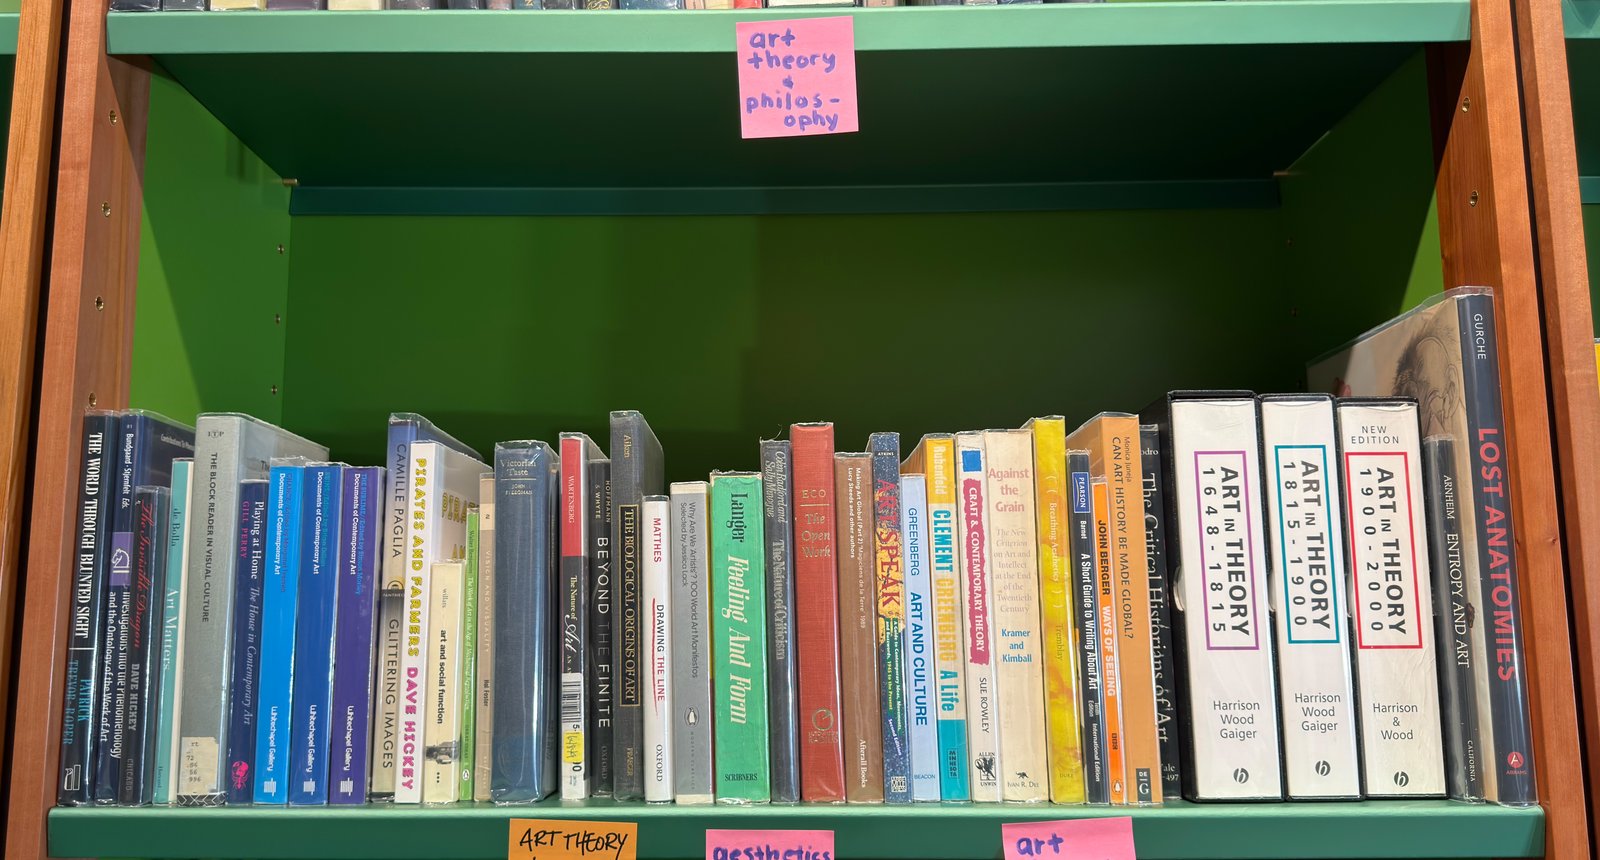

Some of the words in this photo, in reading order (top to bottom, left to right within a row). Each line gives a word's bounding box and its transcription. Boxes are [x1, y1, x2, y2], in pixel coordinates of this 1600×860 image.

[750, 28, 796, 49] art
[747, 50, 836, 73] theory
[783, 110, 838, 131] ophy
[1474, 313, 1486, 360] GURCHE
[88, 433, 102, 454] THE
[1351, 435, 1400, 445] EDITION
[1361, 426, 1387, 434] NEW
[210, 453, 218, 470] THE
[1112, 437, 1121, 460] CAN
[1478, 428, 1503, 498] LOST
[86, 458, 101, 495] WORLD
[394, 444, 407, 502] CAMILLE
[933, 446, 947, 495] Rubenfeld
[988, 467, 1029, 482] Against
[1114, 463, 1123, 483] ART
[1301, 460, 1322, 506] ART
[209, 471, 217, 501] BLOCK
[413, 458, 427, 531] PIRATES
[801, 489, 827, 499] ECO
[1000, 484, 1019, 496] the
[1142, 473, 1157, 509] The
[1220, 466, 1241, 512] ART
[1376, 467, 1397, 513] ART
[1443, 475, 1455, 519] ARNHEIM
[969, 487, 978, 516] CRAFT
[995, 501, 1025, 512] Grain
[1115, 487, 1126, 533] HISTORY
[81, 499, 98, 548] THROUGH
[207, 502, 216, 535] READER
[251, 501, 264, 535] Playing
[392, 508, 405, 558] PAGLIA
[624, 509, 635, 533] THE
[726, 493, 748, 543] Langer
[804, 512, 826, 525] The
[970, 520, 978, 529] &
[1080, 520, 1088, 539] Barnet
[1224, 519, 1235, 532] IN
[1304, 513, 1316, 526] IN
[1381, 519, 1392, 532] IN
[206, 538, 213, 547] IN
[240, 528, 248, 558] PERRY
[253, 538, 260, 547] at
[653, 518, 662, 562] MATTHES
[801, 530, 831, 543] Open
[908, 508, 920, 575] GREENBERG
[933, 510, 953, 572] CLEMENT
[1098, 520, 1108, 548] JOHN
[1118, 537, 1127, 549] BE
[1145, 512, 1162, 580] Critical
[204, 549, 213, 580] VISUAL
[251, 550, 261, 579] Home
[411, 535, 424, 571] AND
[772, 540, 784, 560] The
[801, 545, 831, 558] Work
[77, 554, 94, 603] BLUNTED
[598, 537, 610, 614] BEYOND
[624, 536, 635, 606] BIOLOGICAL
[773, 561, 785, 598] Nature
[971, 531, 983, 610] CONTEMPORARY
[1082, 561, 1091, 583] Short
[1100, 551, 1110, 595] BERGER
[1120, 553, 1130, 586] MADE
[1306, 532, 1331, 629] THEORY
[1447, 534, 1463, 598] ENTROPY
[250, 586, 260, 602] The
[722, 555, 750, 623] Feeling
[1082, 584, 1092, 608] Guide
[1225, 538, 1250, 636] THEORY
[1382, 538, 1407, 634] THEORY
[1484, 505, 1514, 681] ANATOMIES
[202, 582, 211, 622] CULTURE
[407, 576, 423, 657] FARMERS
[774, 599, 786, 609] of
[910, 591, 922, 621] ART
[1084, 609, 1093, 619] to
[1122, 589, 1133, 639] GLOBAL?
[75, 606, 90, 638] SIGHT
[248, 605, 259, 631] House
[625, 609, 635, 657] ORIGINS
[656, 605, 665, 652] DRAWING
[936, 578, 957, 662] GREENBERG
[974, 614, 984, 652] THEORY
[1001, 628, 1031, 637] Kramer
[1102, 606, 1113, 635] WAYS
[1148, 587, 1166, 678] Historians
[1453, 602, 1467, 634] AND
[247, 634, 256, 642] in
[439, 629, 447, 642] art
[598, 622, 609, 656] THE
[729, 626, 751, 667] And
[774, 611, 787, 660] Criticism
[911, 622, 924, 654] AND
[1009, 641, 1024, 650] and
[1083, 620, 1095, 650] Writing
[1104, 637, 1114, 652] OF
[385, 619, 400, 705] GLITTERING
[439, 645, 447, 660] and
[625, 659, 635, 675] OF
[657, 656, 665, 675] THE
[1002, 654, 1032, 663] Kimball
[1086, 652, 1097, 676] About
[1456, 639, 1469, 669] ART
[130, 664, 140, 690] DAVE
[242, 646, 256, 707] Contemporary
[438, 662, 446, 687] social
[625, 676, 635, 701] ART
[940, 669, 958, 679] A
[979, 677, 988, 694] SUE
[1089, 677, 1098, 690] Art
[1106, 655, 1116, 696] SEEING
[63, 660, 79, 744] TREVOR-ROPER
[77, 679, 92, 721] PATRICK
[405, 667, 418, 715] DAVE
[598, 665, 609, 727] FINITE
[657, 679, 665, 701] LINE
[730, 673, 752, 724] Form
[913, 658, 927, 726] CULTURE
[941, 685, 960, 711] Life
[1157, 684, 1170, 707] of
[1294, 693, 1341, 704] Harrison
[129, 694, 139, 731] HICKEY
[244, 710, 253, 725] Art
[437, 689, 445, 724] function
[980, 697, 989, 733] ROWLEY
[1213, 700, 1260, 711] Harrison
[1220, 714, 1254, 725] Wood
[1302, 706, 1335, 717] Wood
[1372, 703, 1418, 714] Harrison
[1157, 712, 1171, 742] Art
[1219, 728, 1257, 741] Gaiger
[1301, 721, 1338, 734] Gaiger
[1380, 730, 1414, 740] Wood
[1392, 717, 1400, 726] &
[383, 712, 395, 769] IMAGES
[402, 721, 416, 790] HICKEY
[1467, 740, 1476, 782] CALIFORNIA
[519, 828, 562, 851] ART
[563, 830, 629, 860] THEORY
[713, 845, 831, 860] aesthetics
[1016, 832, 1065, 857] art
